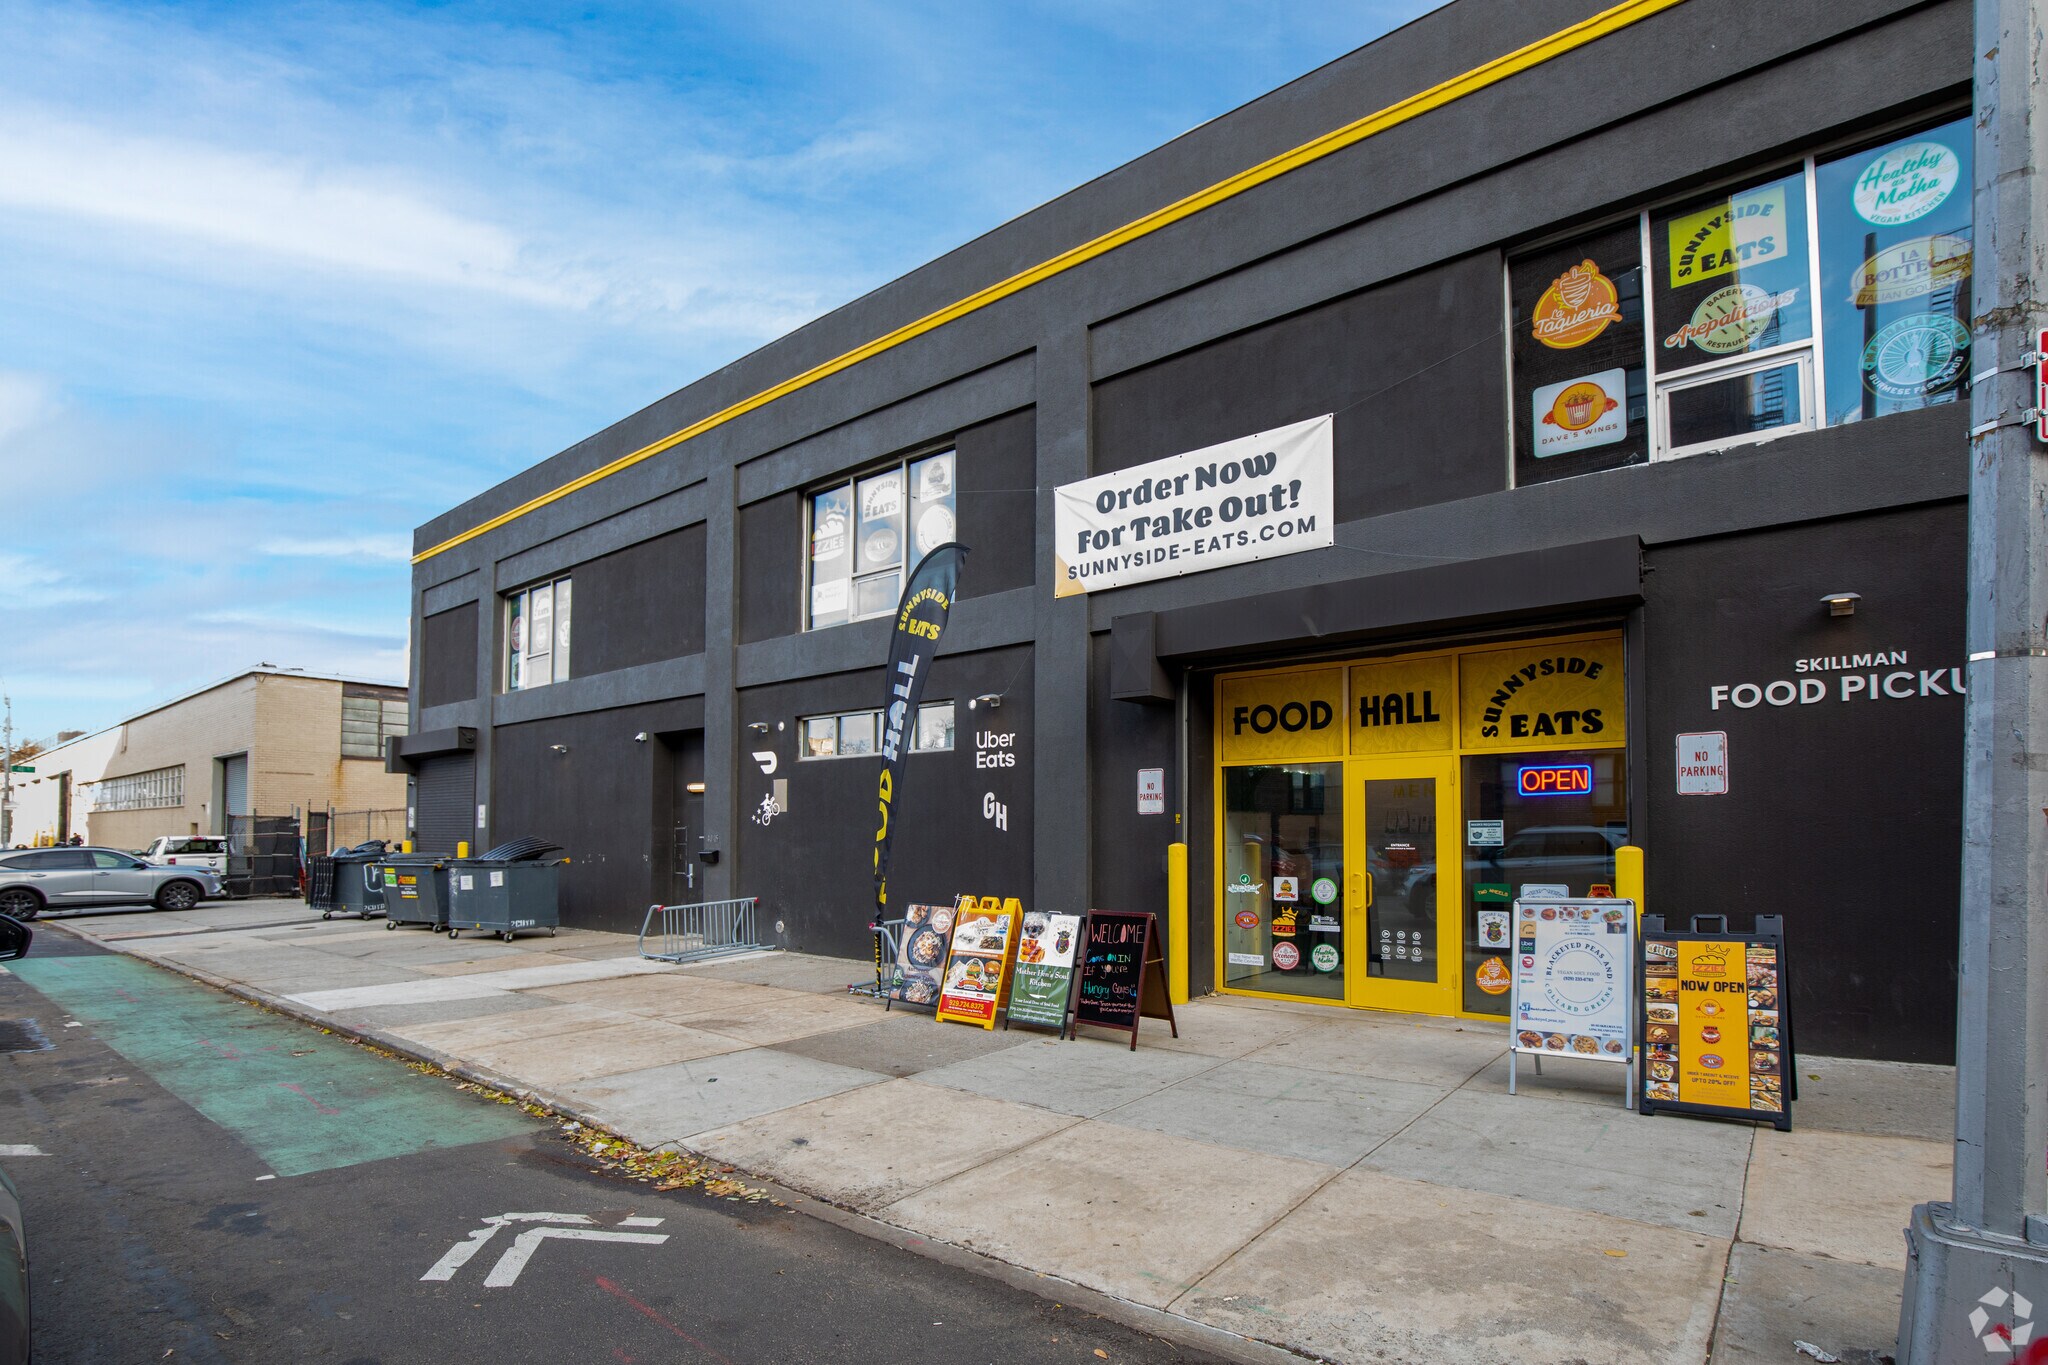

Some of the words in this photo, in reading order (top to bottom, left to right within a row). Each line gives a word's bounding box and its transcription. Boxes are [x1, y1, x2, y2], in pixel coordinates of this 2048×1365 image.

[1862, 148, 1947, 190] Healthy
[1875, 177, 1940, 210] Motha
[1892, 178, 1905, 187] as
[1870, 213, 1900, 223] VEGAN
[1905, 191, 1947, 220] KITCHEN
[1678, 203, 1774, 278] SUNNYSIDE
[1701, 235, 1776, 273] EATS
[1901, 249, 1919, 261] LA
[1706, 287, 1744, 307] BAKERY
[1858, 289, 1902, 303] ITALIAN
[1536, 301, 1616, 335] Taqueria
[1551, 308, 1565, 320] La
[1706, 325, 1759, 349] RESTAURANT
[1869, 373, 1911, 395] BURMESE
[1542, 431, 1579, 445] DAVE'S
[1585, 423, 1618, 436] WINGS
[1096, 473, 1189, 514] Order
[1195, 451, 1277, 491] Now
[865, 479, 898, 517] SUNNYSIDE
[872, 499, 897, 517] EATS
[1078, 525, 1126, 554] For
[1130, 505, 1213, 542] Take
[1219, 479, 1302, 523] Out!
[1068, 515, 1316, 580] SUNNYSIDE-EATS.COM
[898, 587, 950, 631] SUNNYSIDE
[908, 618, 941, 640] EATS
[1794, 650, 1908, 673] SKILLMAN
[1481, 656, 1604, 738] SUNNYSIDE
[1710, 678, 1826, 711] FOOD
[1841, 667, 1967, 702] PICKU
[1233, 700, 1333, 735] FOOD
[1359, 690, 1440, 727] HALL
[1510, 708, 1604, 738] EATS
[976, 731, 1016, 749] Uber
[976, 750, 1015, 769] Eats
[1695, 751, 1709, 763] NO
[1521, 769, 1589, 792] OPEN
[1680, 765, 1724, 777] PARKING
[1140, 793, 1162, 801] PARKING
[1147, 782, 1154, 790] NO
[983, 791, 1008, 832] GH
[1091, 923, 1147, 944] WELCOME
[1546, 942, 1581, 976] BLACKEYED
[1585, 944, 1605, 959] PEAS
[1603, 960, 1613, 979] AND
[1016, 967, 1037, 977] Mother
[1055, 971, 1070, 980] Soul
[1029, 978, 1052, 988] Kitchen
[1478, 978, 1511, 986] Taqueria
[1083, 980, 1110, 1000] Hungry
[1545, 983, 1579, 1012] COLLARD
[1585, 987, 1613, 1012] GREENS
[1681, 980, 1710, 992] NOW
[1713, 981, 1745, 993] OPEN
